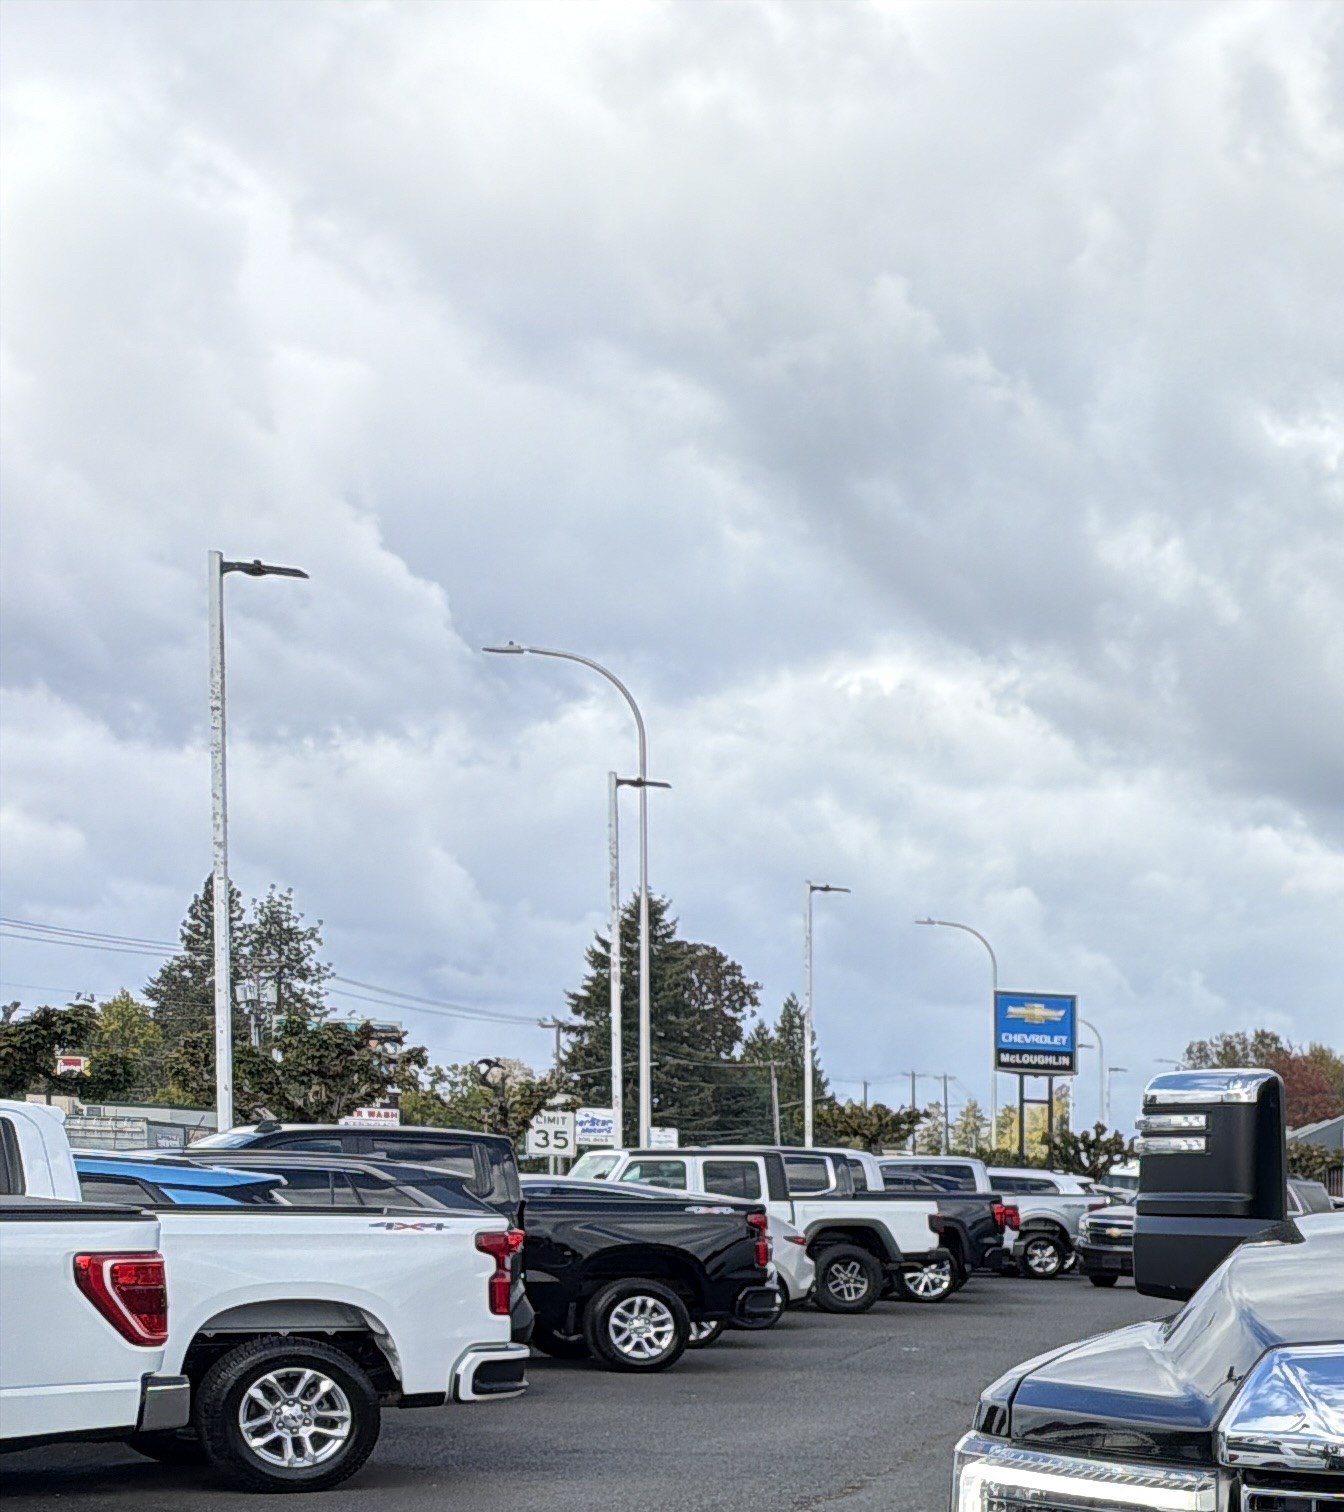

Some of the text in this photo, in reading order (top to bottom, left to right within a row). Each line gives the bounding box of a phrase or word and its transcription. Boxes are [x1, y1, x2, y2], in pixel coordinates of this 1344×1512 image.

[1001, 1032, 1068, 1046] CHEVROLET
[1000, 1052, 1071, 1067] McLOUGHLIN
[535, 1114, 567, 1126] LIMIT
[533, 1129, 569, 1150] 35
